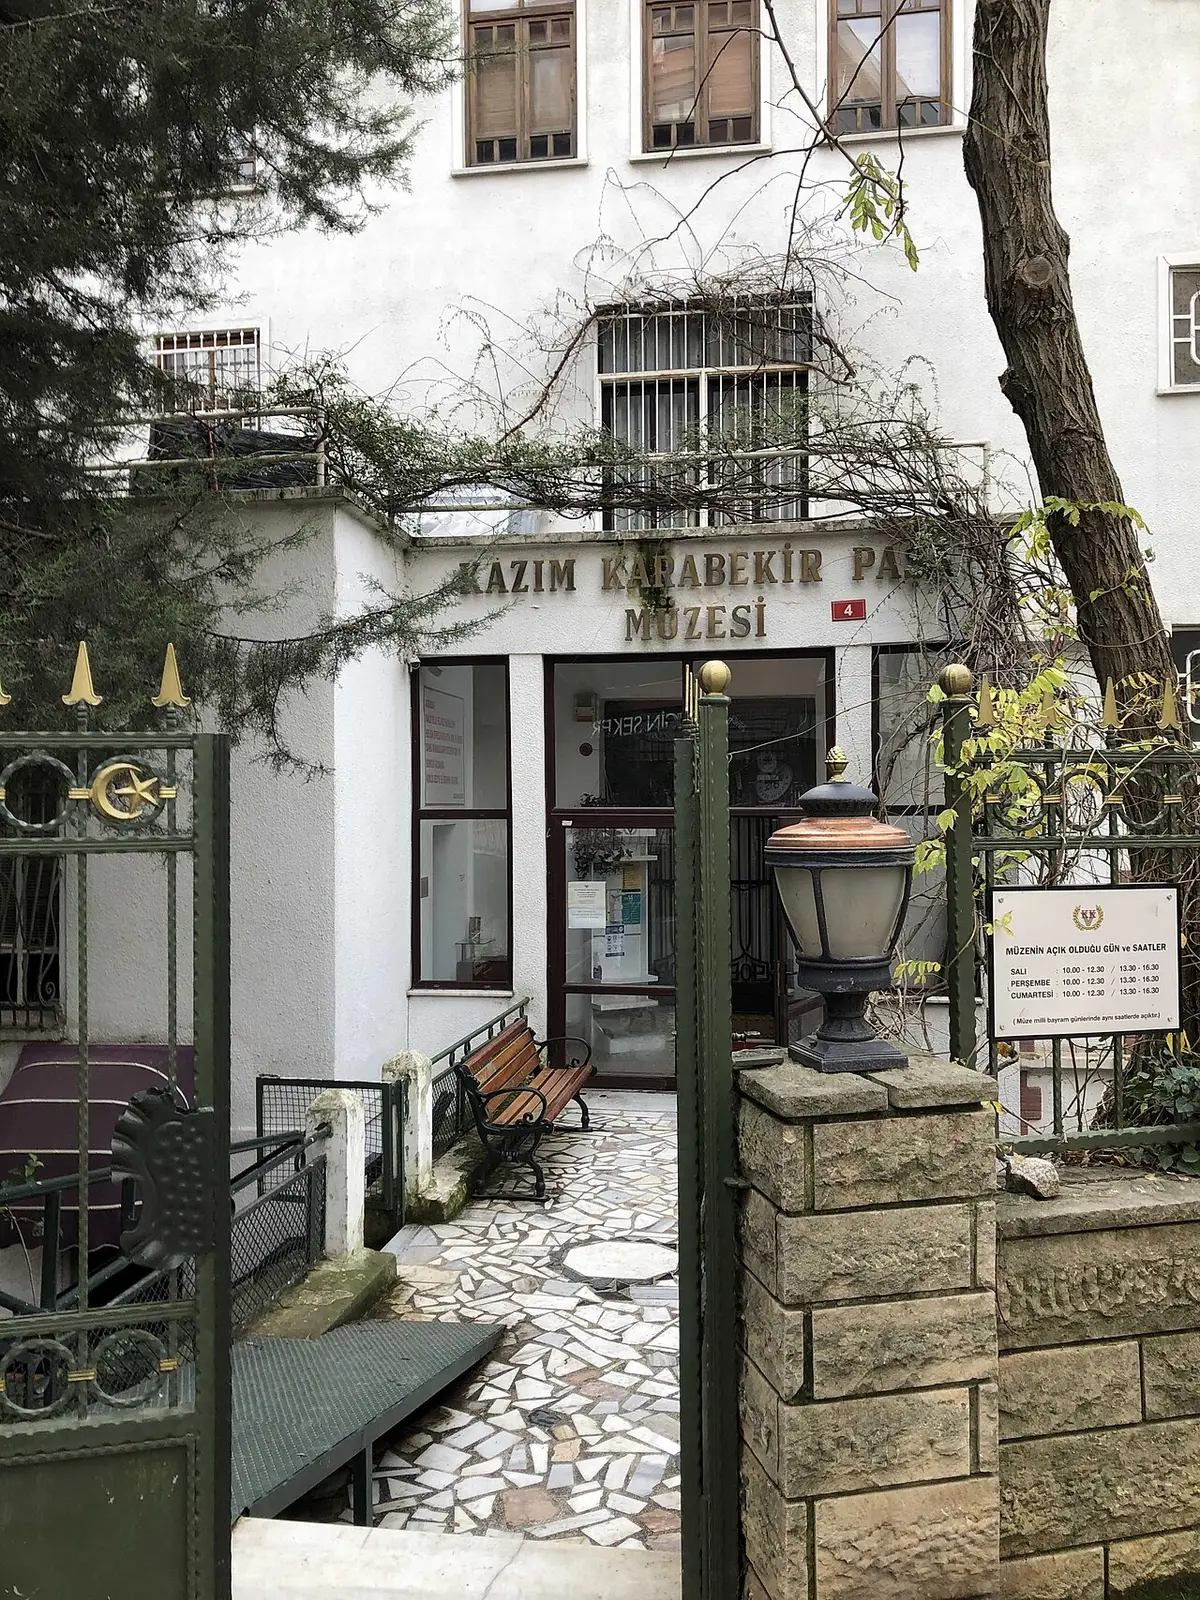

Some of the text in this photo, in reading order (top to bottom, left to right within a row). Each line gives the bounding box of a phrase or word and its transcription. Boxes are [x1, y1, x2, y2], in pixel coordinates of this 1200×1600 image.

[601, 542, 823, 590] KARABEKİR
[852, 545, 920, 581] PA
[843, 603, 854, 616] 4
[624, 595, 767, 642] MÜZESİ
[1005, 945, 1044, 956] MÜZENİN
[1046, 946, 1067, 956] AÇIK
[1068, 944, 1101, 954] OLDUĞU
[1103, 943, 1120, 953] GÜN
[1132, 943, 1167, 952] SAATLER
[1010, 979, 1051, 988] PERŞEMBE
[1010, 990, 1054, 999] CUMARTESİ
[1070, 1015, 1100, 1023] günlerinde
